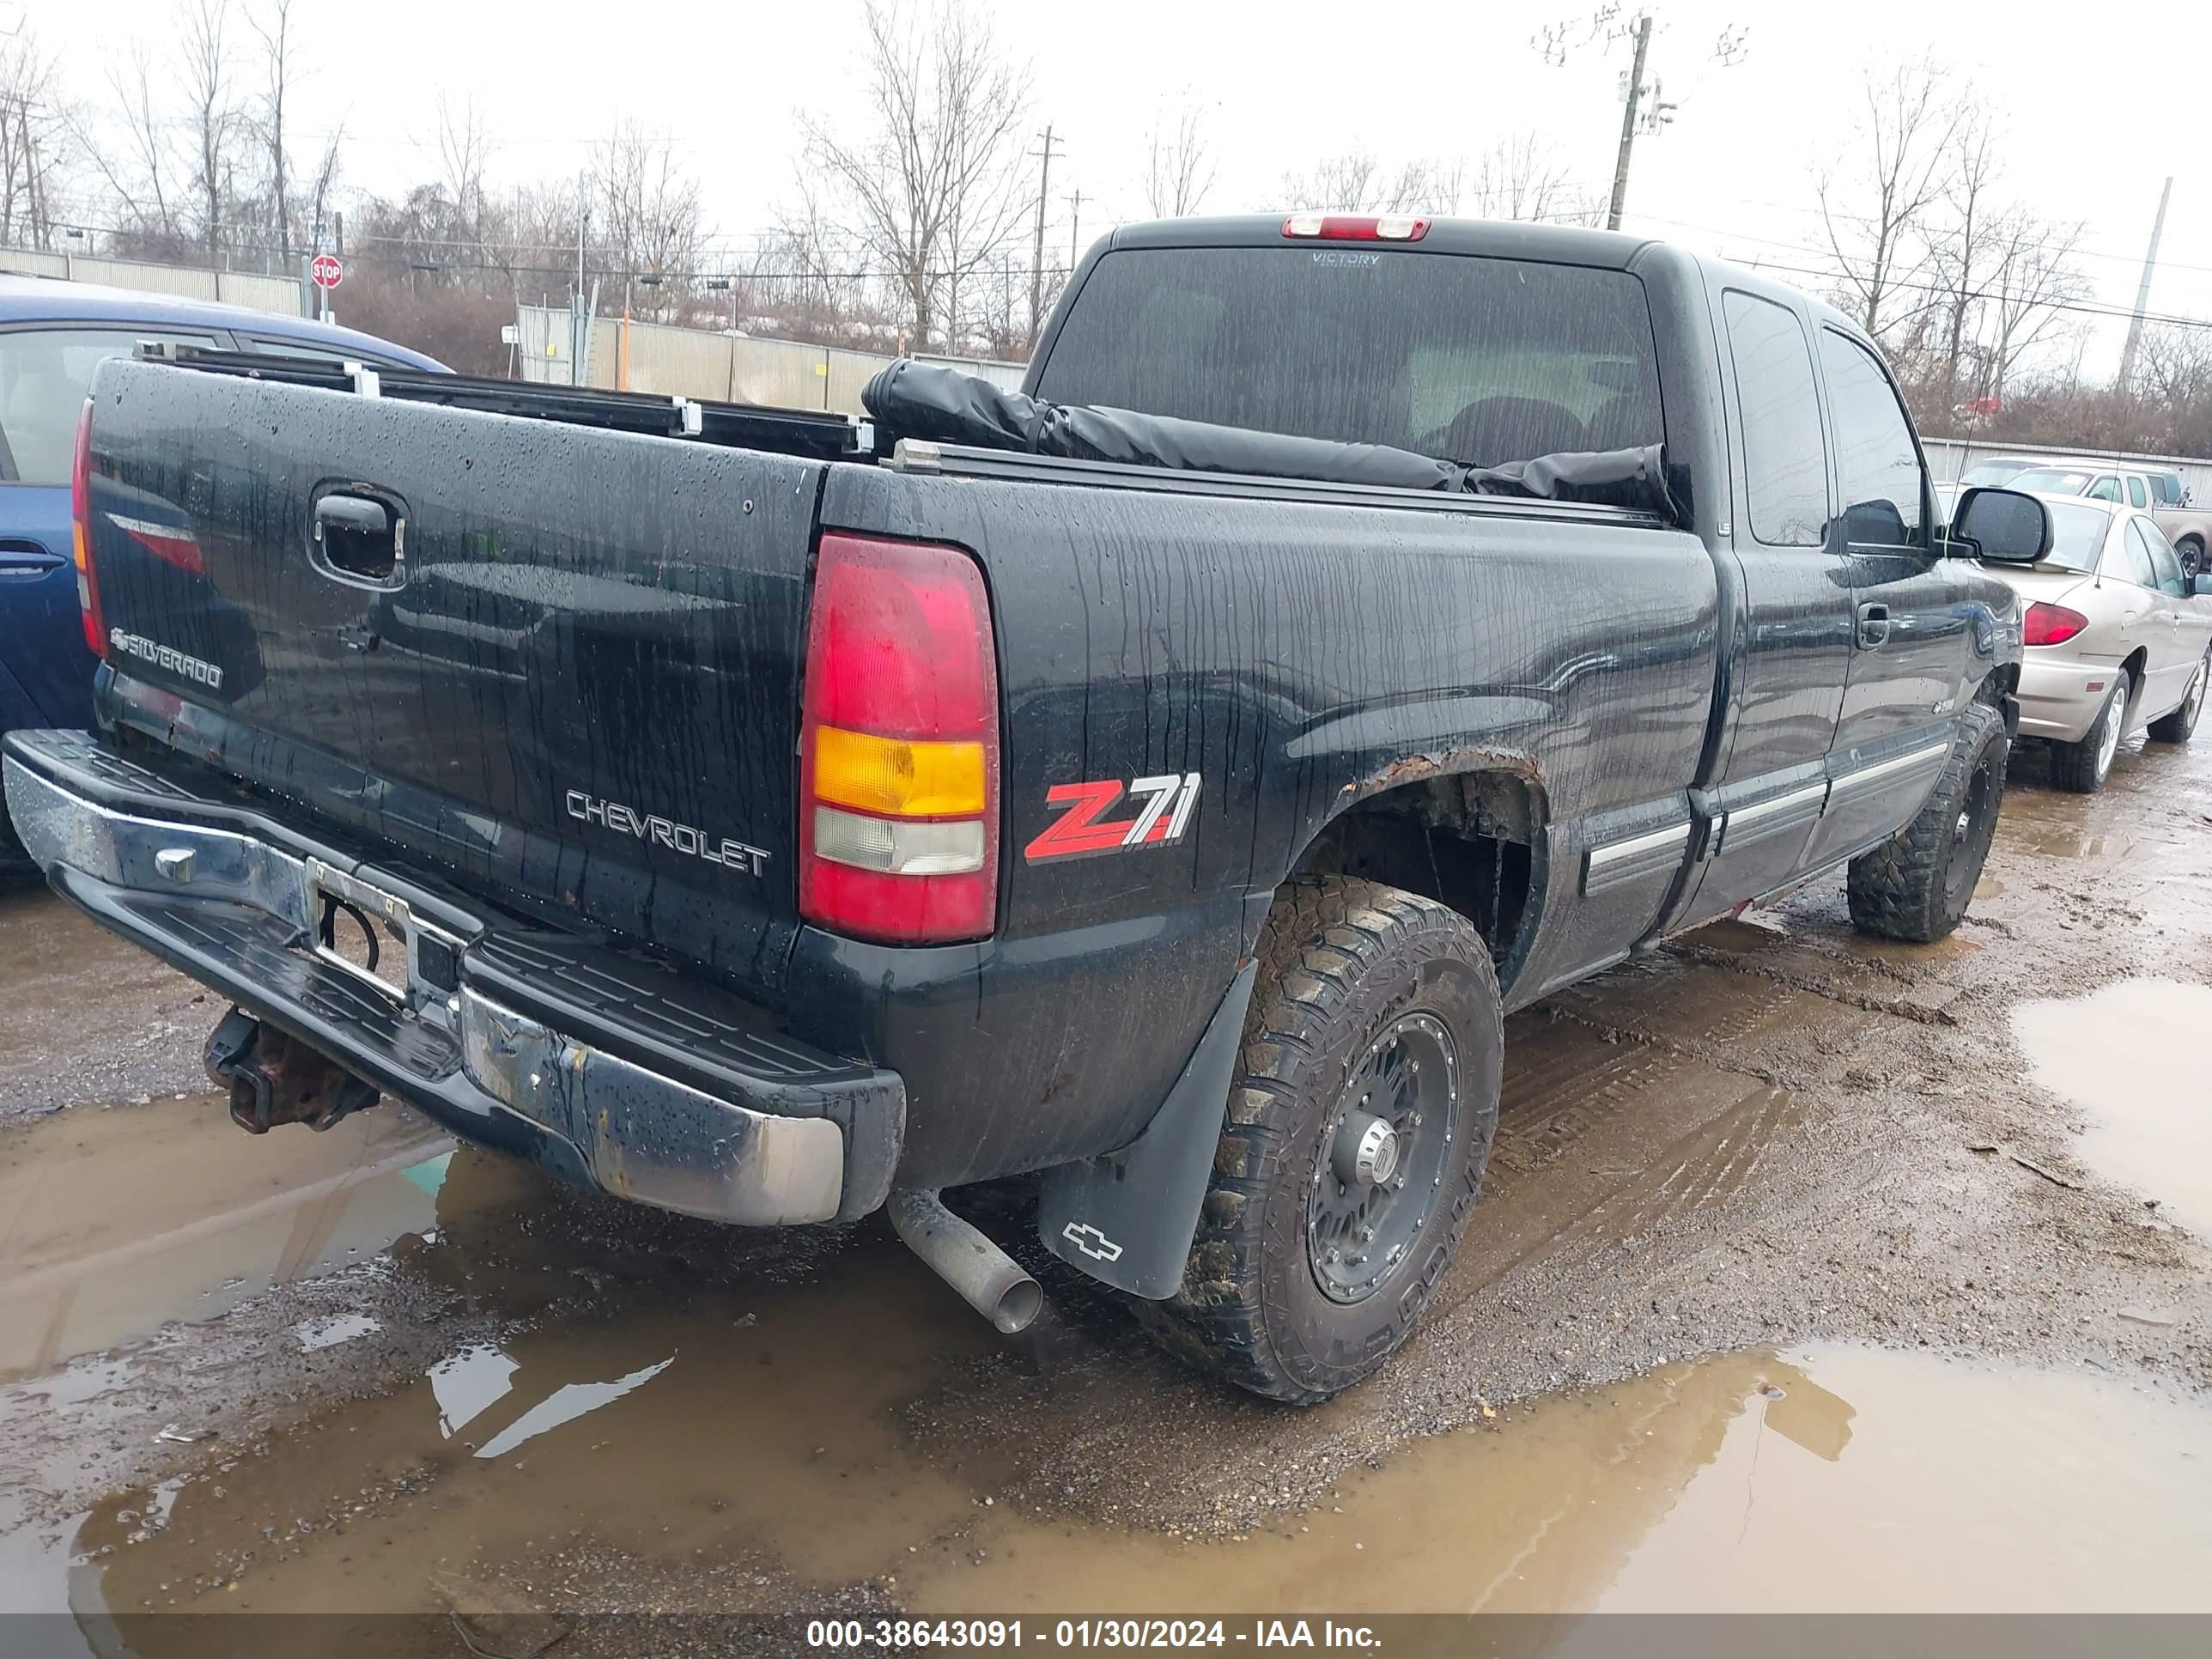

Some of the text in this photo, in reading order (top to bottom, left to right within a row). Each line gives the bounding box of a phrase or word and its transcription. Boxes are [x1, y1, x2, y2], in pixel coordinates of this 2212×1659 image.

[313, 264, 340, 279] STOP
[1312, 252, 1380, 265] VICTORY
[128, 634, 224, 689] SILVERADO
[566, 789, 771, 878] CHEVROLET
[1024, 772, 1202, 866] Z71
